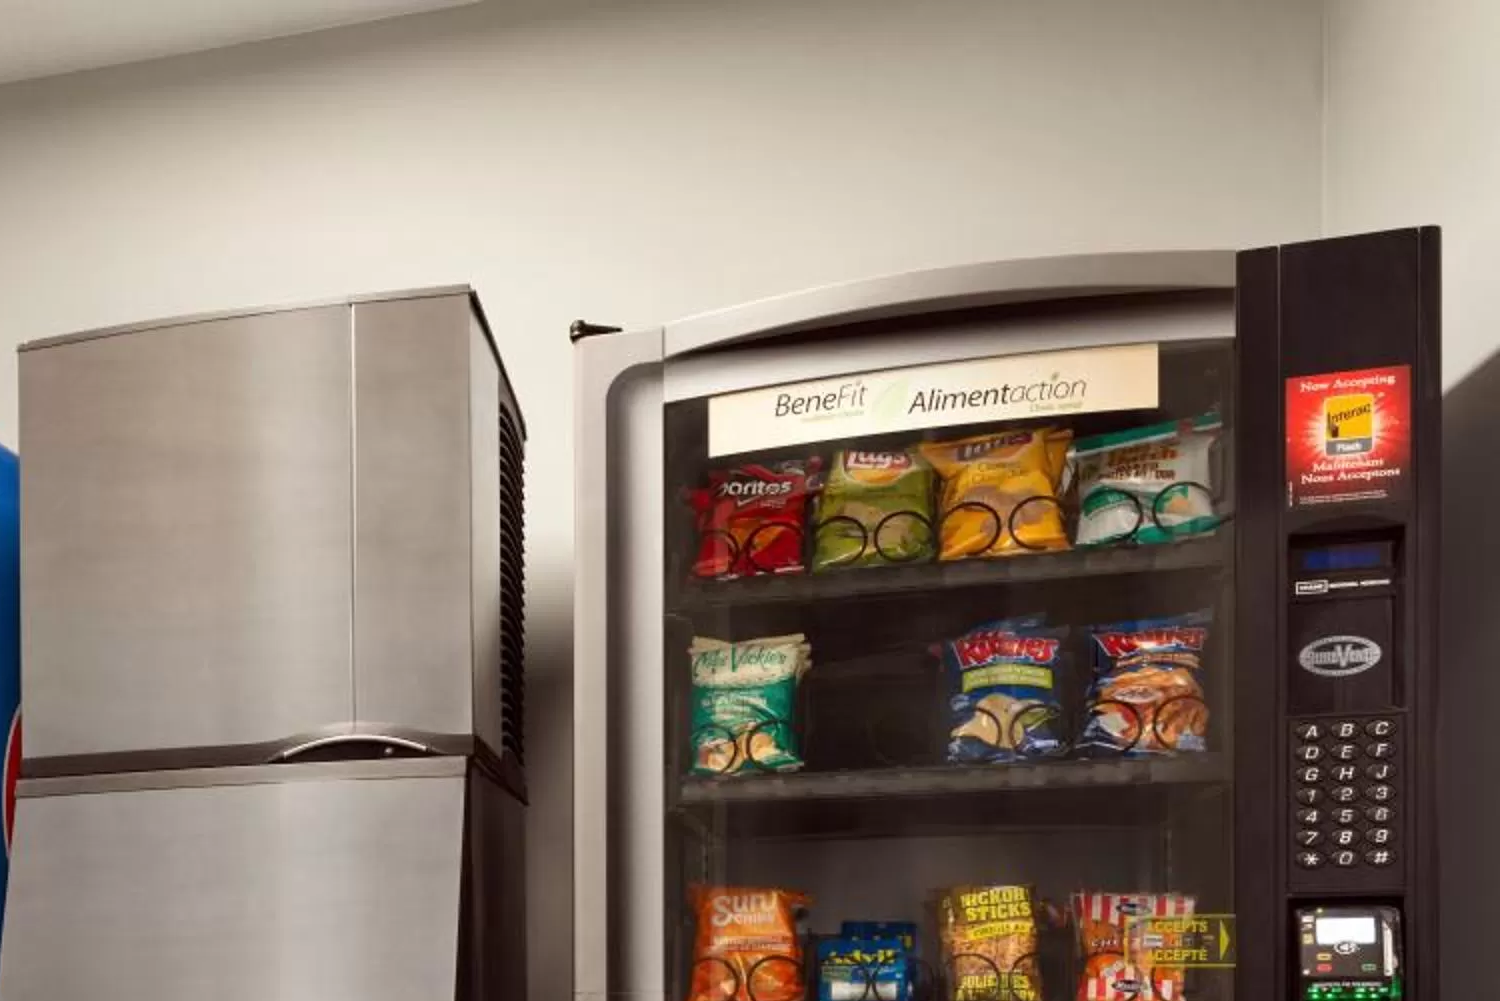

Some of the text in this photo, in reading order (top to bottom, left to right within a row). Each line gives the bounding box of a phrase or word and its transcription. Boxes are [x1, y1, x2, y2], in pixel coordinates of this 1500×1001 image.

[1333, 375, 1397, 390] Accepting
[774, 371, 1088, 417] BeneFit Alimentaction
[1326, 402, 1372, 425] Interac
[1305, 725, 1318, 738] A
[1340, 723, 1354, 737] B
[1375, 721, 1389, 735] C
[1305, 746, 1319, 759] D
[1341, 745, 1353, 759] E
[1376, 743, 1388, 757] F
[1305, 767, 1319, 781] G
[1340, 766, 1354, 780] H
[1376, 765, 1388, 779] J
[1308, 789, 1316, 803] 1
[1341, 787, 1353, 801] 2
[1375, 785, 1388, 800] 3
[1305, 810, 1317, 823] 4
[1340, 809, 1353, 822] 5
[1306, 831, 1319, 845] 7
[1339, 831, 1353, 844] 8
[1375, 829, 1388, 843] 9
[1339, 851, 1353, 865] 0
[965, 902, 1031, 922] STICKS
